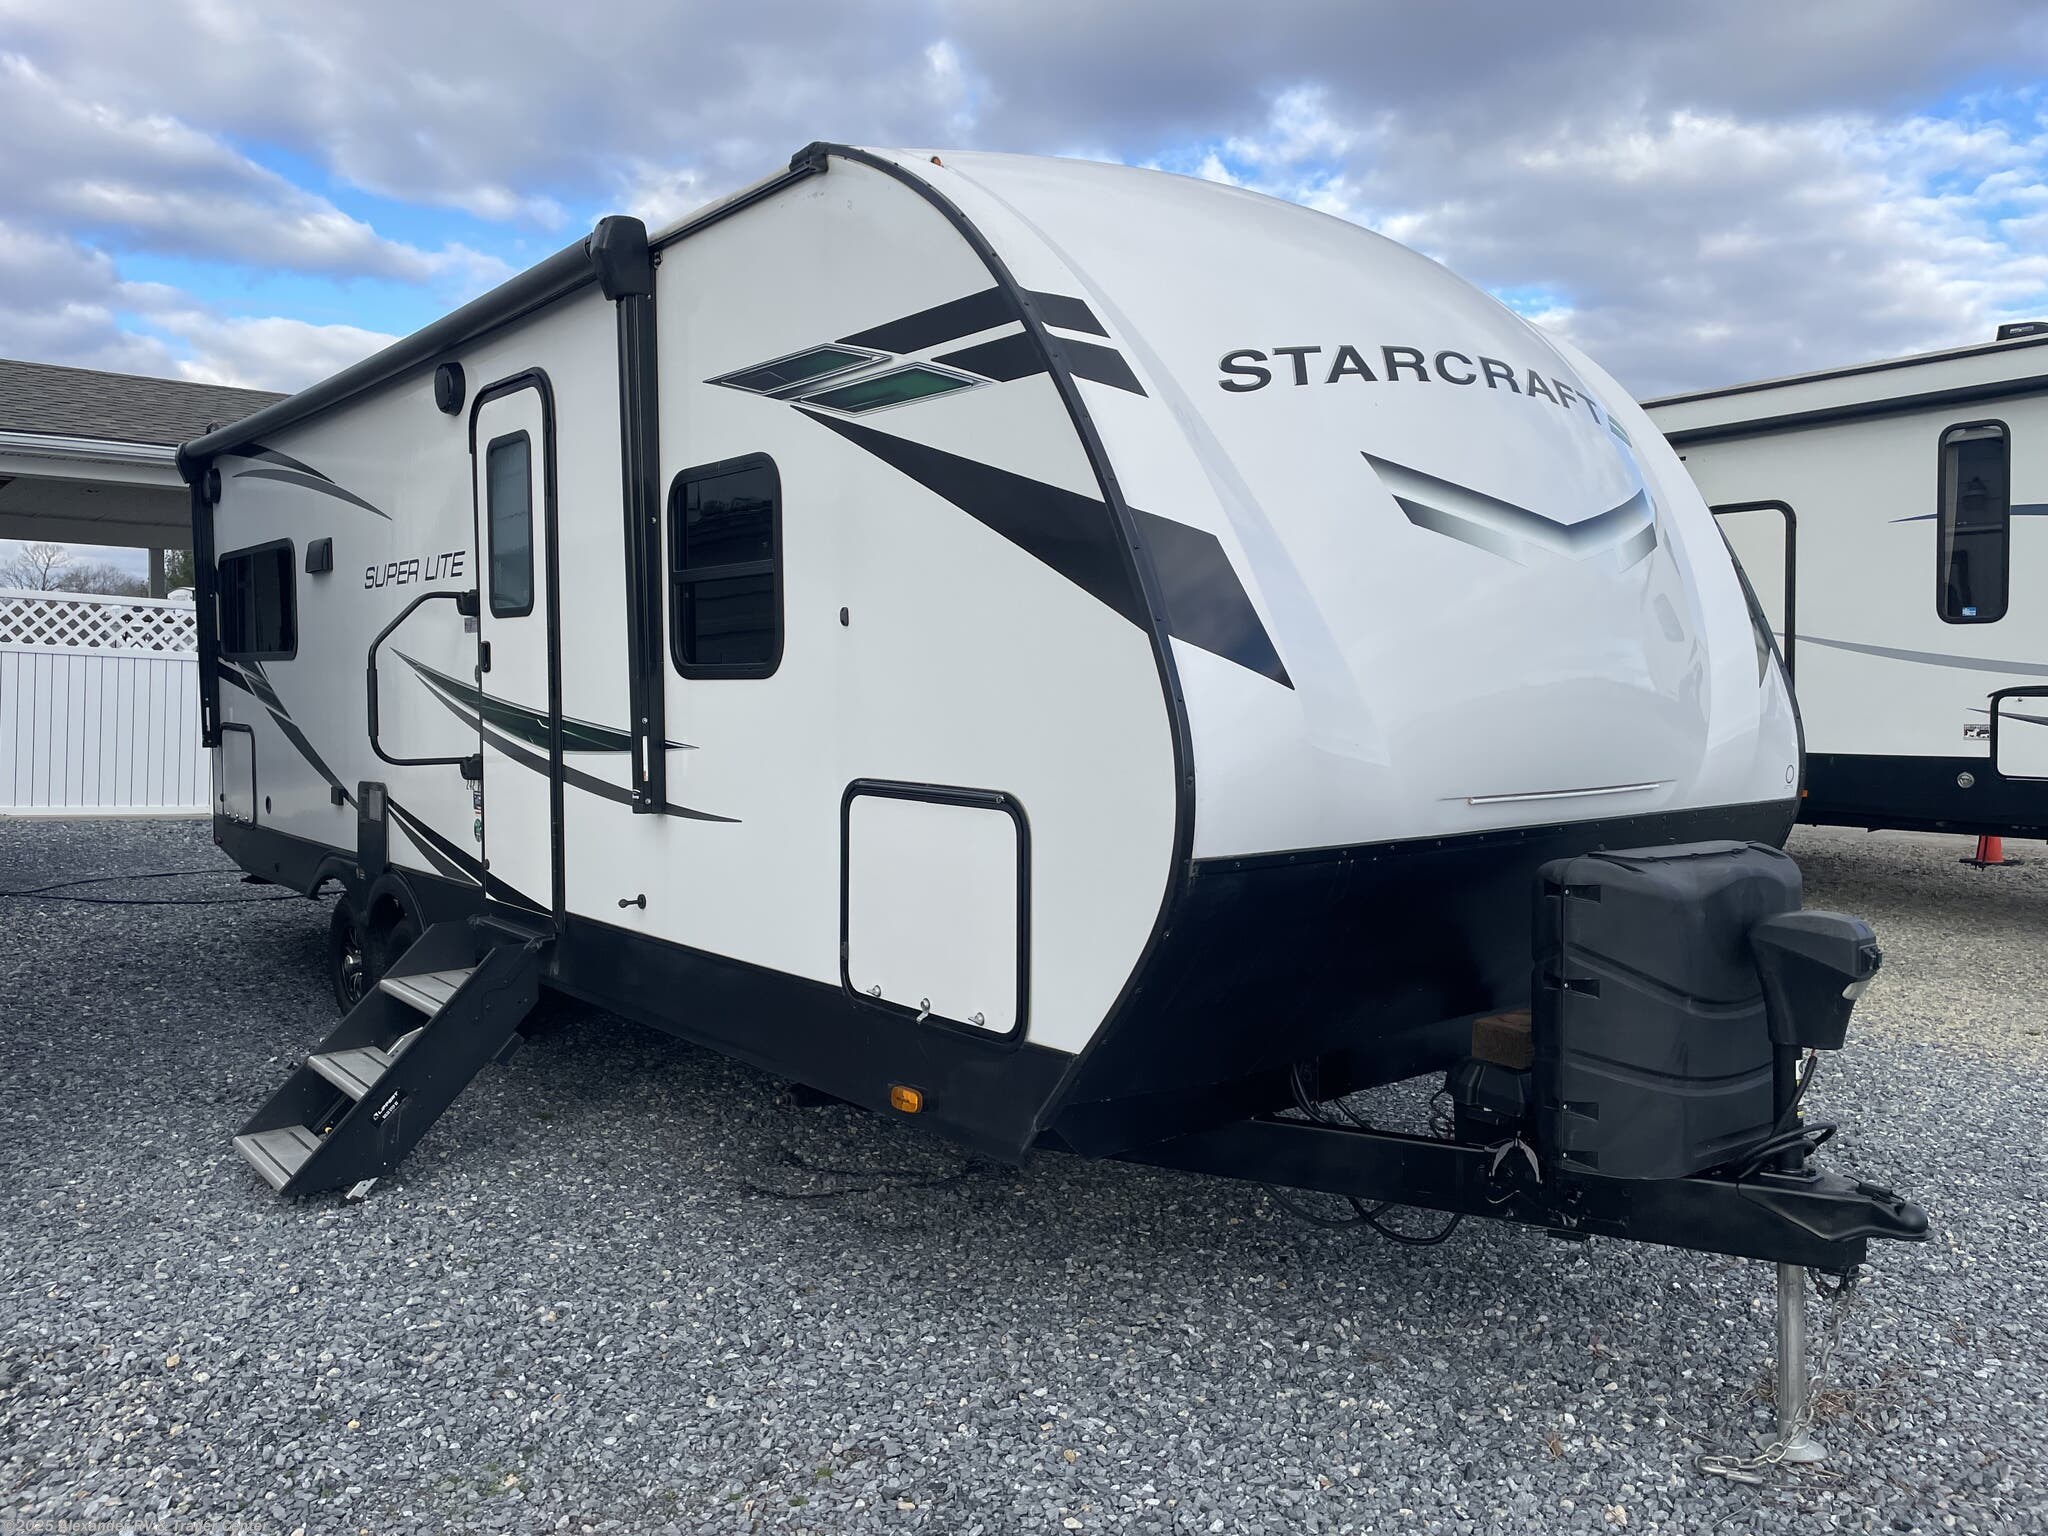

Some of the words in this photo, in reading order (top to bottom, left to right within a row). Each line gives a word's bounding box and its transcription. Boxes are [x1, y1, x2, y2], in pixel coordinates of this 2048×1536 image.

[1218, 345, 1602, 425] STARCRAFT
[364, 558, 419, 589] SUPER
[425, 550, 466, 581] LITE
